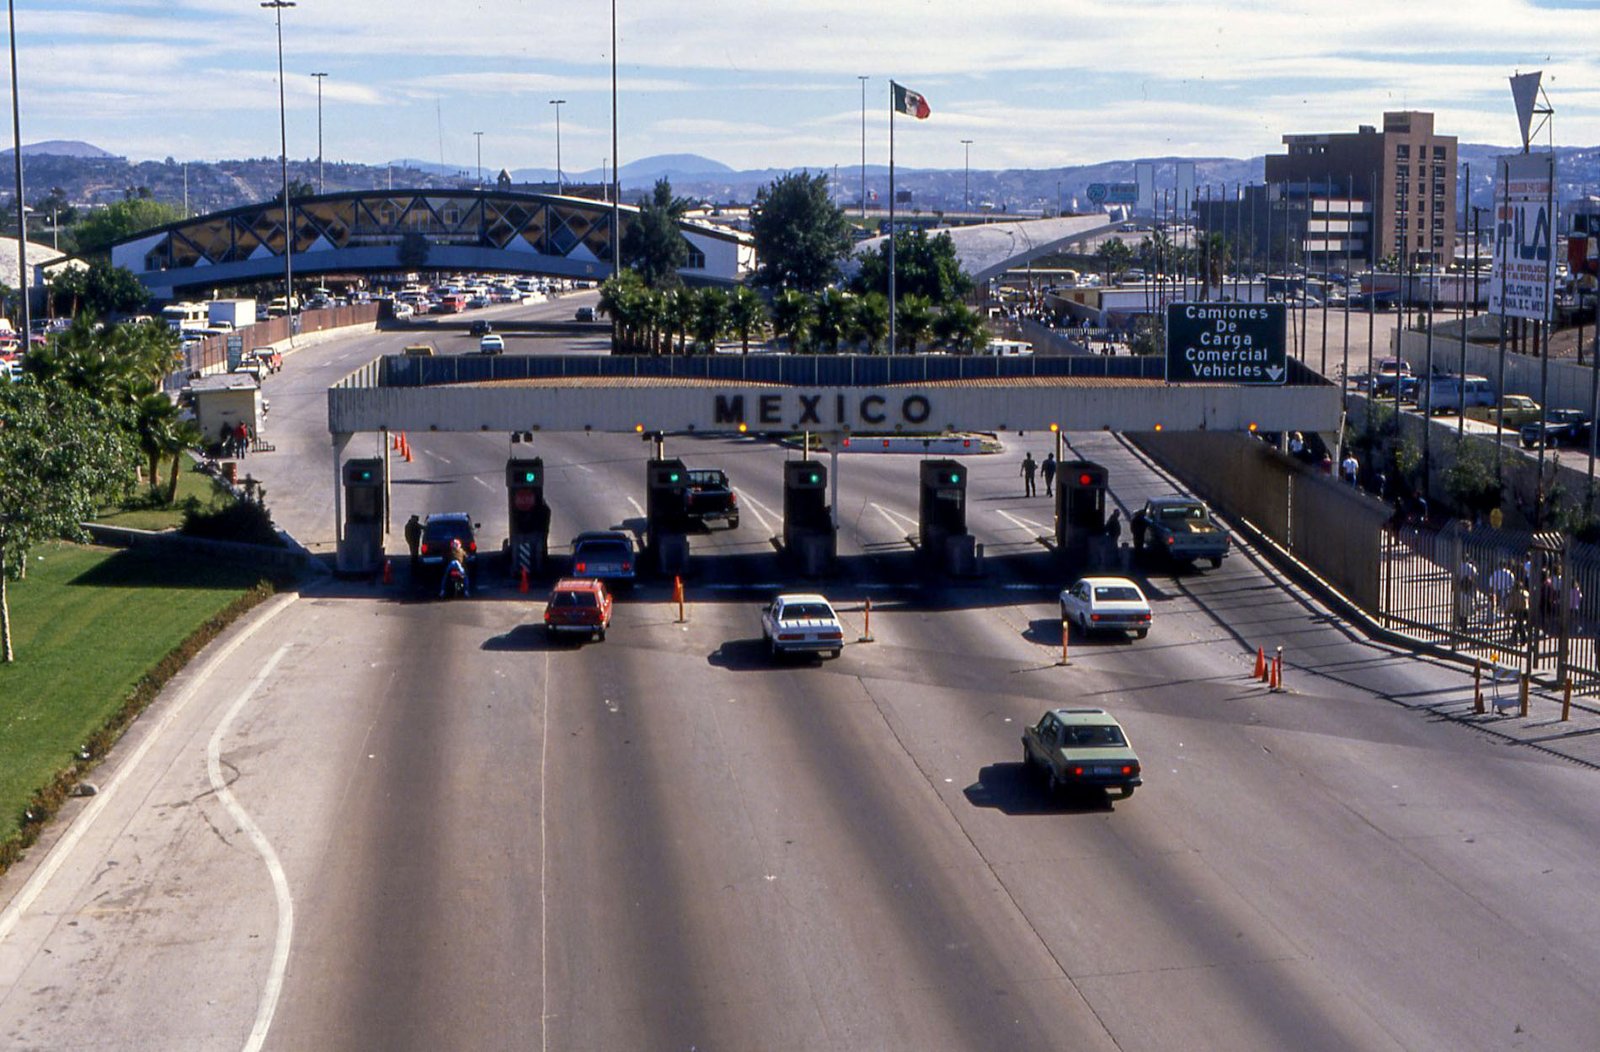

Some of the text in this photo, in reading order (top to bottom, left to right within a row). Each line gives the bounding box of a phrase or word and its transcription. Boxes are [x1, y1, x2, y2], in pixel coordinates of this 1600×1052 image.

[1185, 305, 1268, 319] Camiones
[1216, 319, 1237, 333] De
[1200, 331, 1252, 350] Carga
[1185, 347, 1268, 361] Comercial
[1192, 363, 1262, 377] Vehicles
[714, 394, 932, 424] MEXICO
